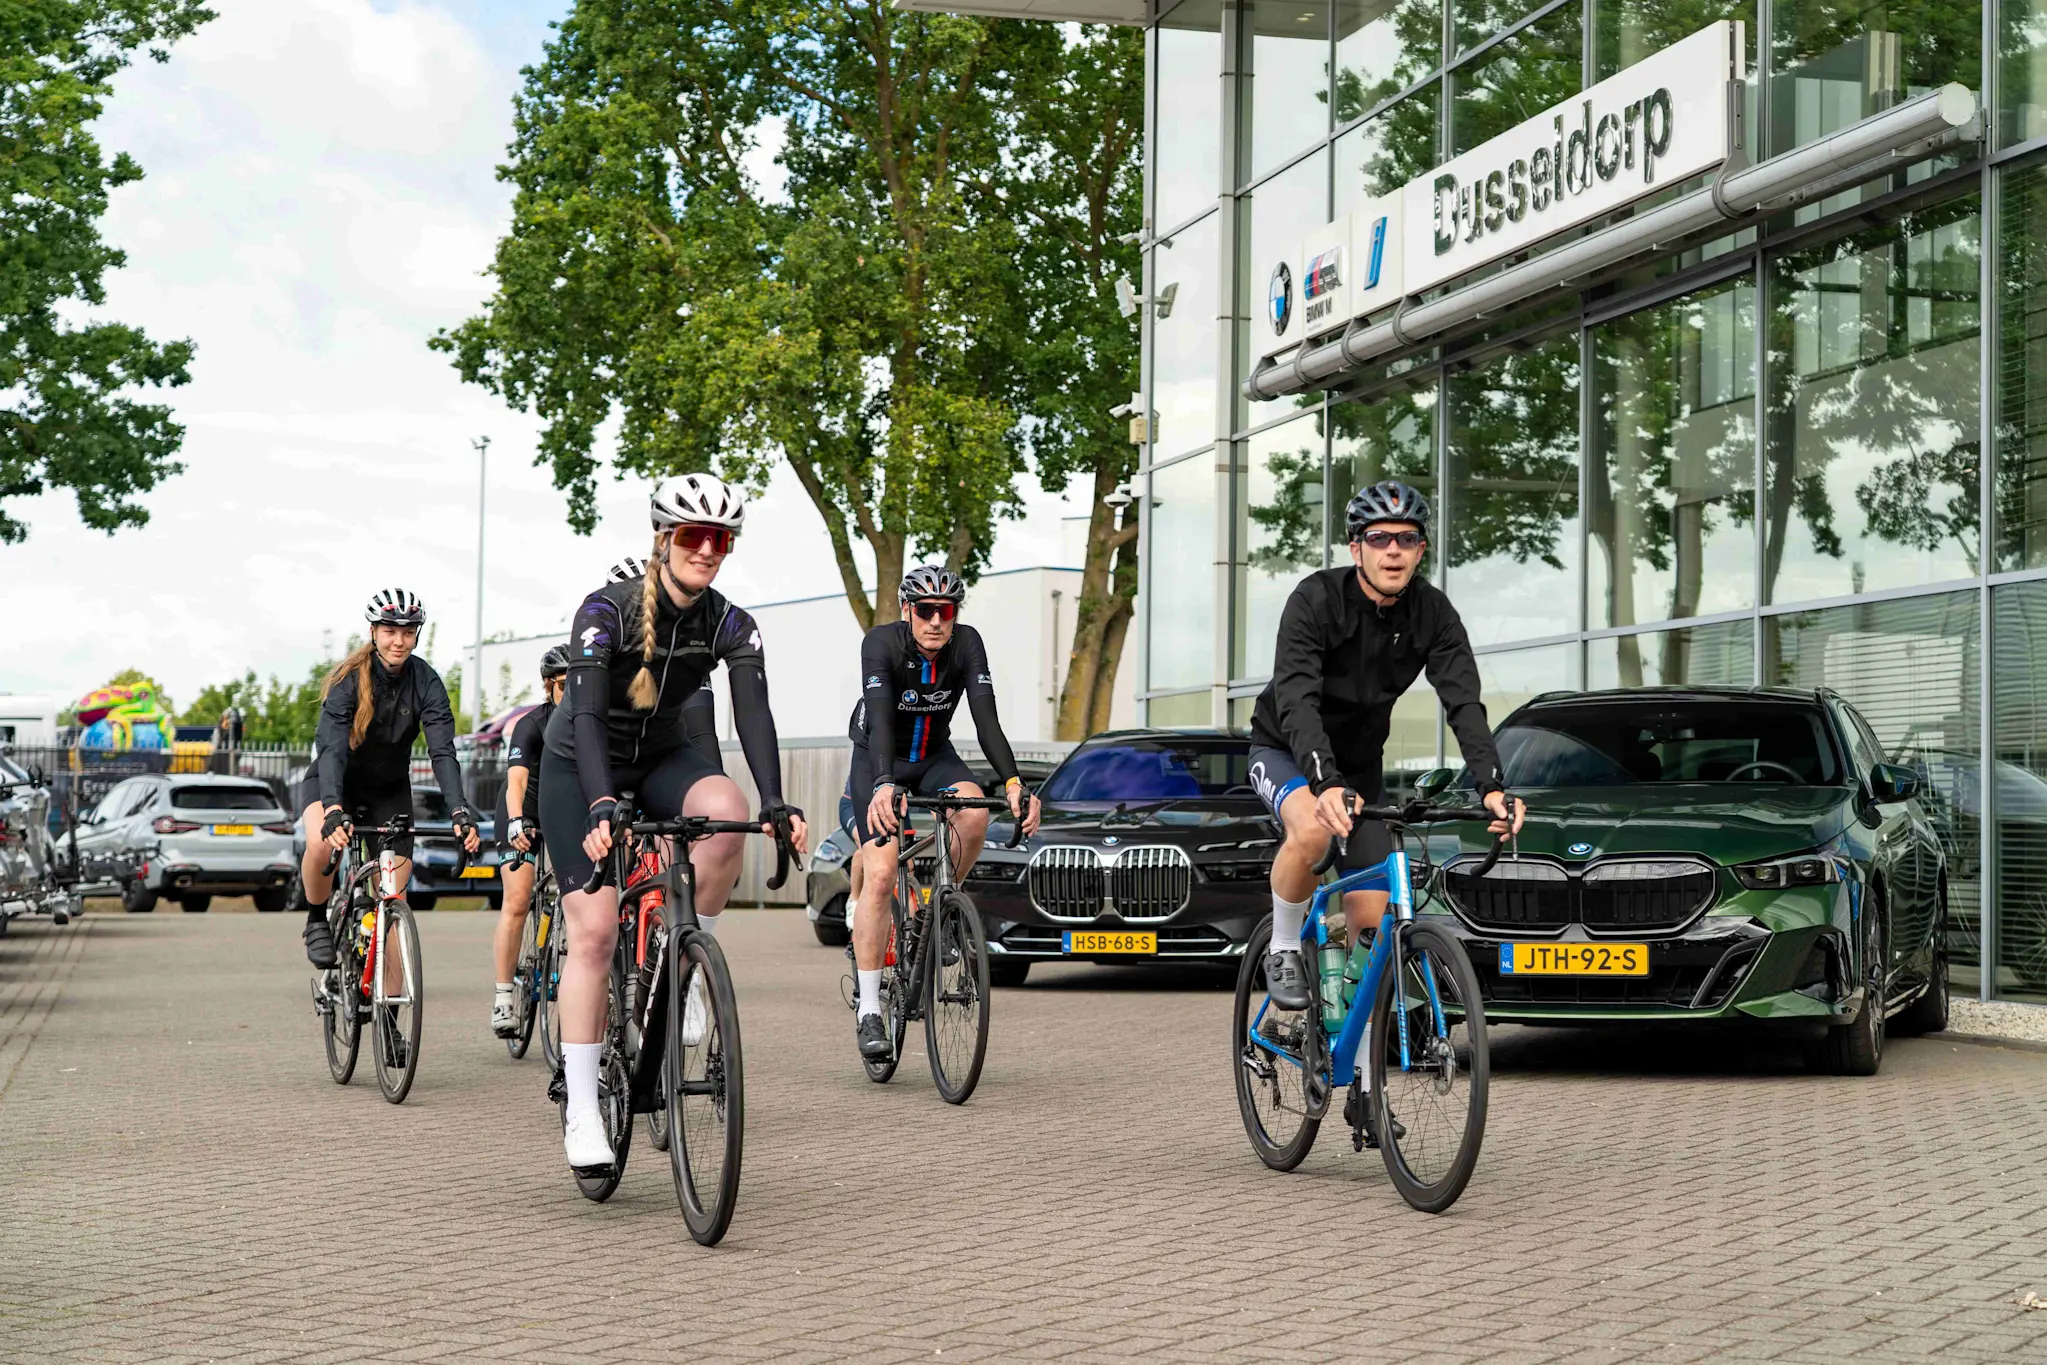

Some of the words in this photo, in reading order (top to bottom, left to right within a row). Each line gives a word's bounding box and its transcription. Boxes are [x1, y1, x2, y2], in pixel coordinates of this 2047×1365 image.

[1434, 87, 1673, 256] Dusseldorp
[1306, 300, 1324, 323] BMW
[1325, 296, 1332, 315] M
[1075, 936, 1150, 950] HSB-68-S
[1501, 960, 1513, 968] NL
[1524, 948, 1637, 970] JTH-92-S
